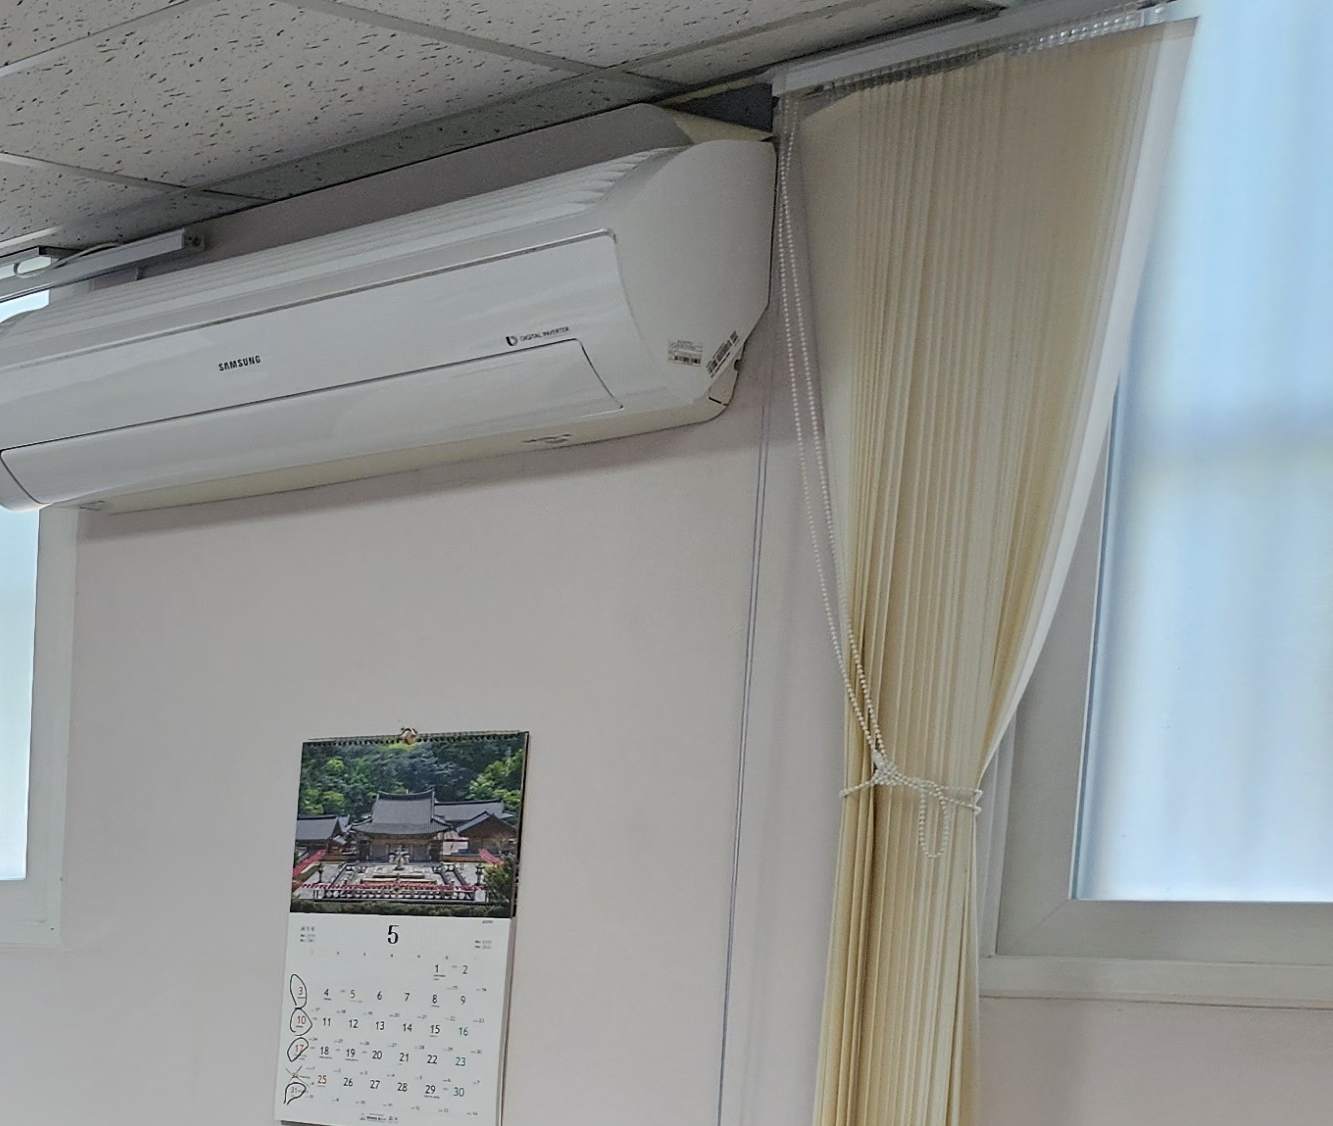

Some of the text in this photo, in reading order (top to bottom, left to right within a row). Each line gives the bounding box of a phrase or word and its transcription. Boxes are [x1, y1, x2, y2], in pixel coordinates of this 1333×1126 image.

[219, 355, 261, 371] SAMSUNG
[387, 925, 399, 944] 5
[435, 964, 468, 974] 1 2
[298, 987, 466, 1004] 3 4 5 6 7 8 9
[298, 1016, 468, 1036] 10 11 12 13 14 15 16
[321, 1047, 329, 1055] 18
[347, 1049, 355, 1058] 19
[372, 1051, 382, 1059] 20
[400, 1053, 409, 1062] 21
[427, 1055, 437, 1064] 22
[456, 1057, 466, 1066] 23
[318, 1075, 327, 1084] 25
[344, 1078, 353, 1086] 26
[370, 1080, 380, 1089] 27
[397, 1083, 408, 1091] 28
[426, 1085, 436, 1094] 29
[453, 1088, 464, 1097] 30
